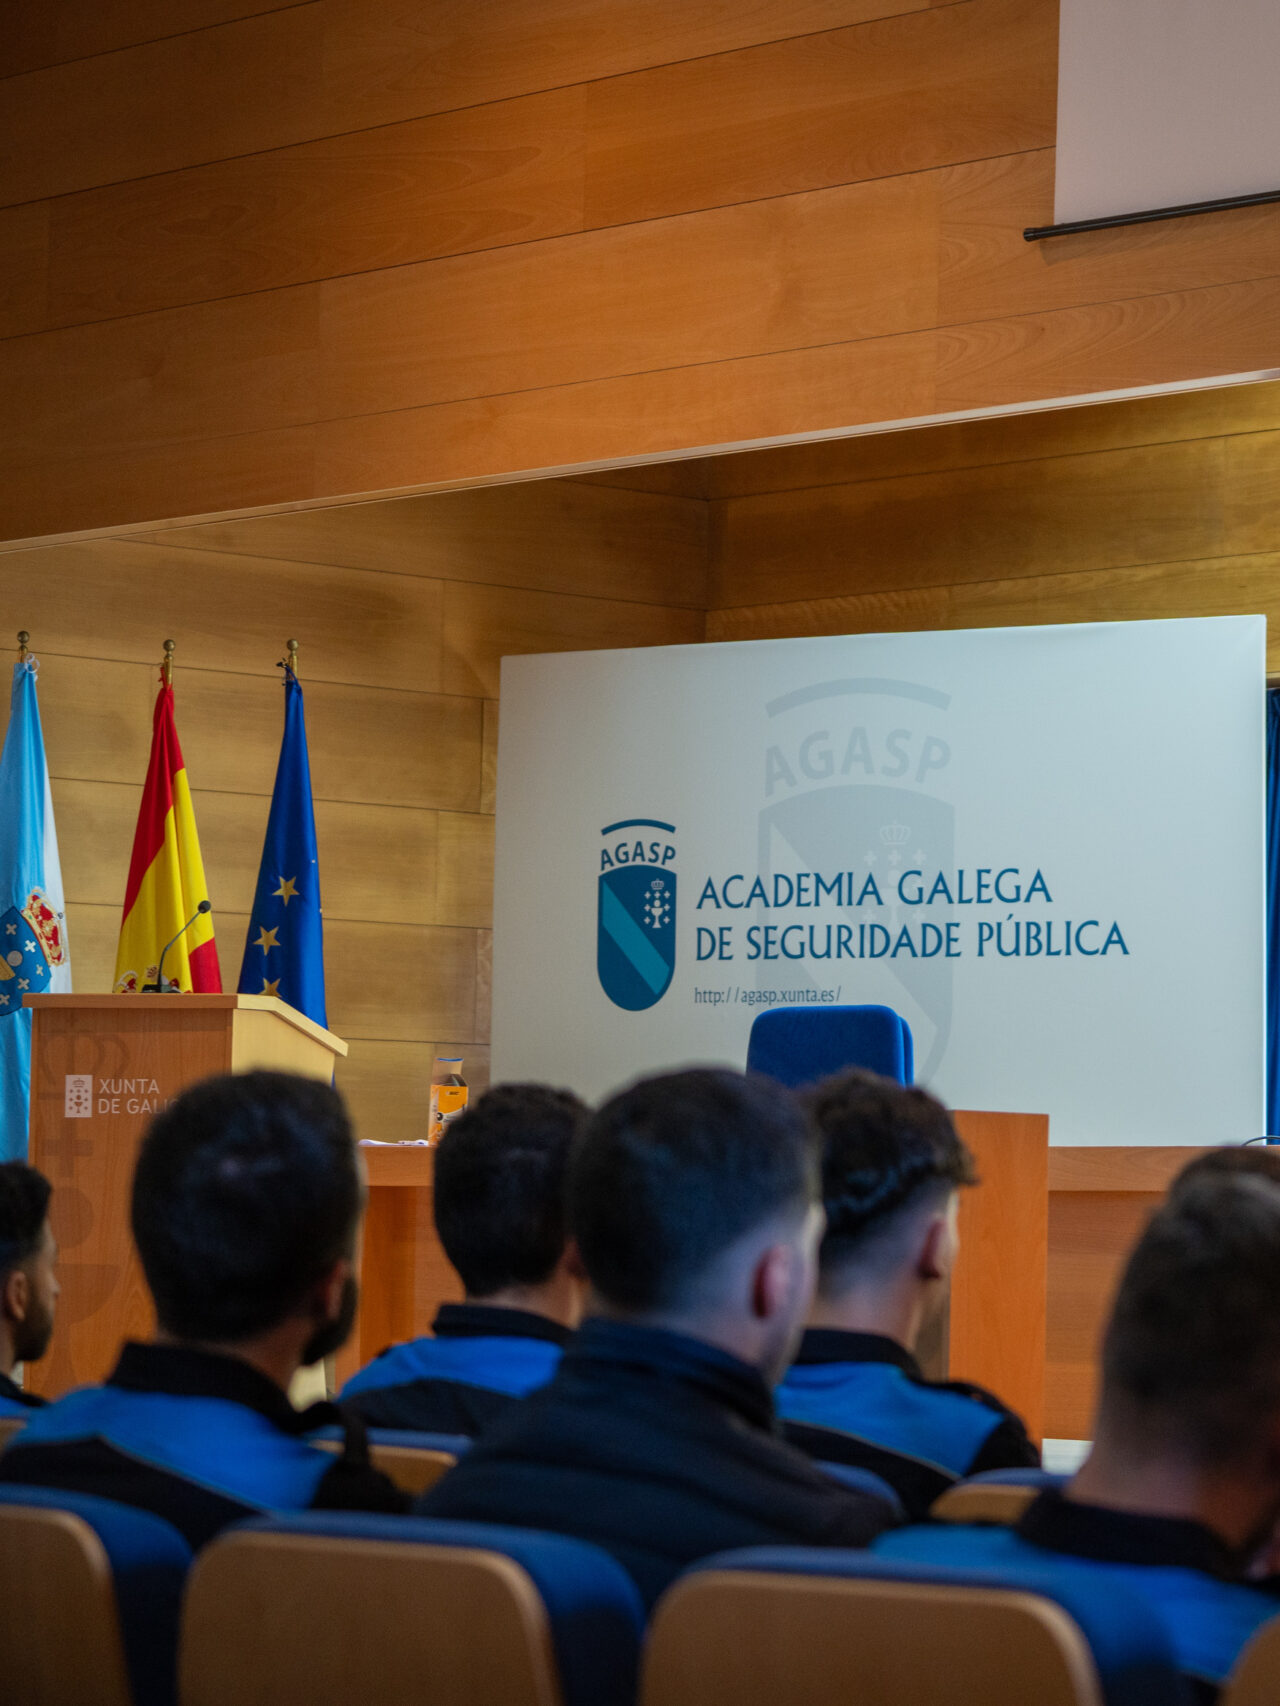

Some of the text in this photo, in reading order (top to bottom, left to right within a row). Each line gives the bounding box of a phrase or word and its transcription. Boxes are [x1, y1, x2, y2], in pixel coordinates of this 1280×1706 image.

[765, 726, 951, 798] AGASP
[601, 841, 676, 871] AGASP
[696, 868, 1053, 909] ACADEMIA GALEGA
[696, 914, 1130, 960] DE SEGURIDADE PÚBLICA
[99, 1078, 160, 1094] XUNTA
[98, 1098, 121, 1114] DE
